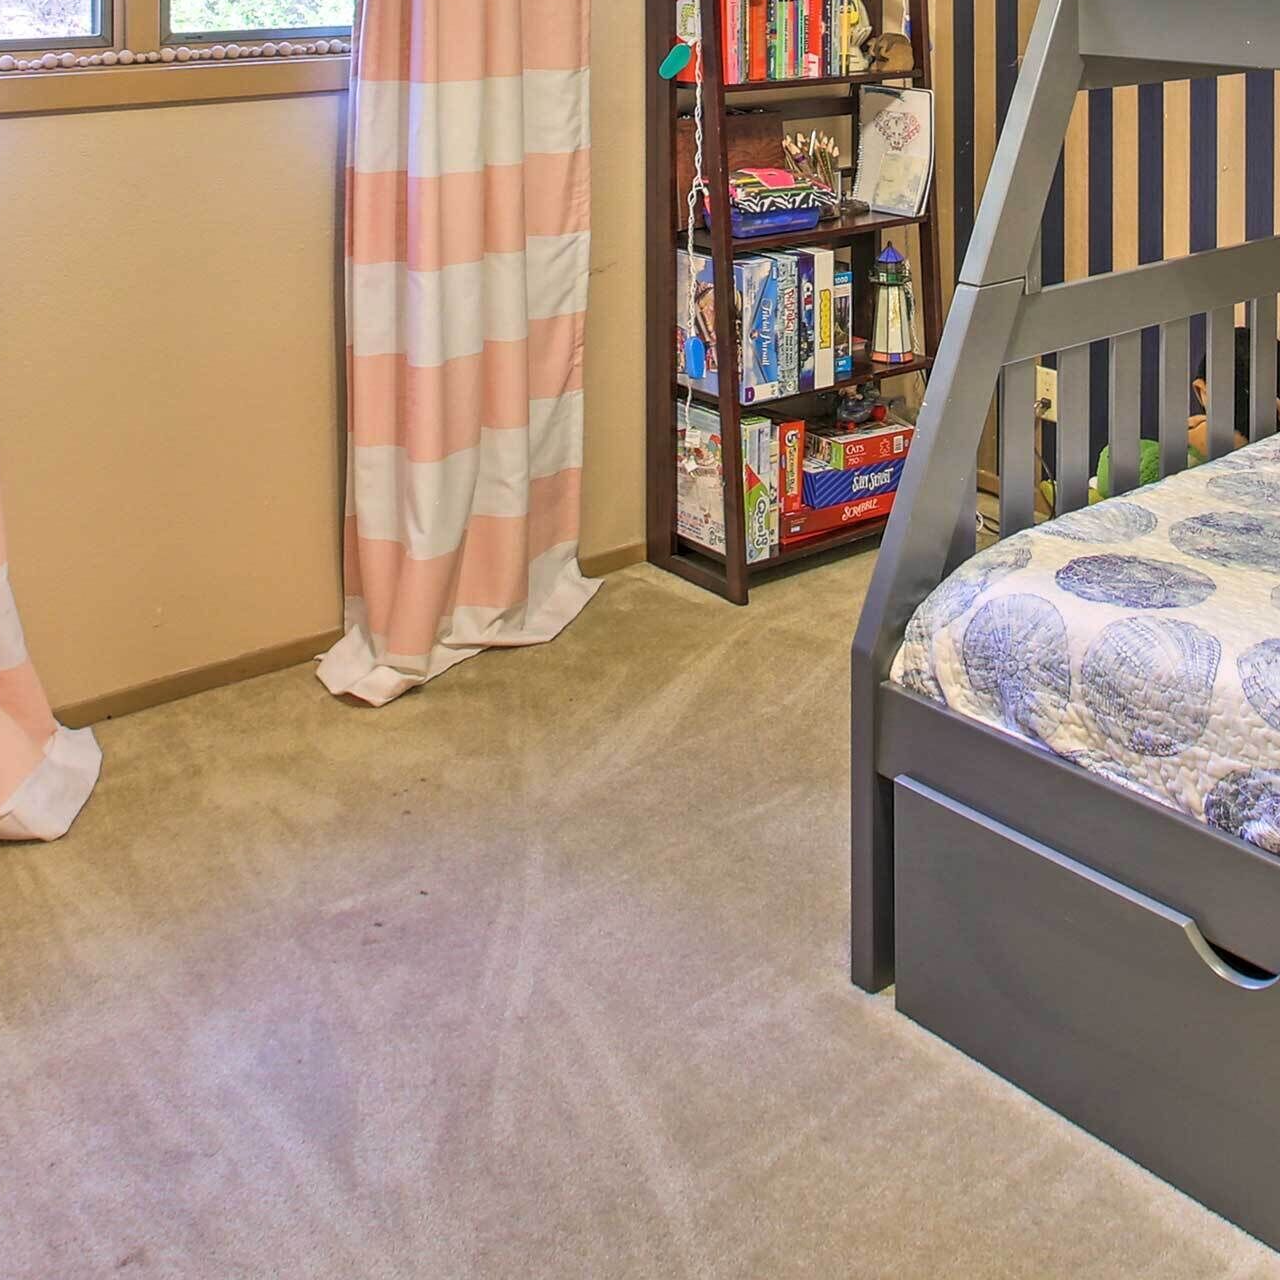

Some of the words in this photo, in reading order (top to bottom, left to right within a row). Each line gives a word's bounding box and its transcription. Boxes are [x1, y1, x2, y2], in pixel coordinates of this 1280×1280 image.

[761, 299, 773, 333] Trivial
[760, 334, 773, 366] Pursuit
[788, 433, 797, 443] 5
[846, 444, 865, 454] CATS
[842, 499, 878, 521] SCRABBLE
